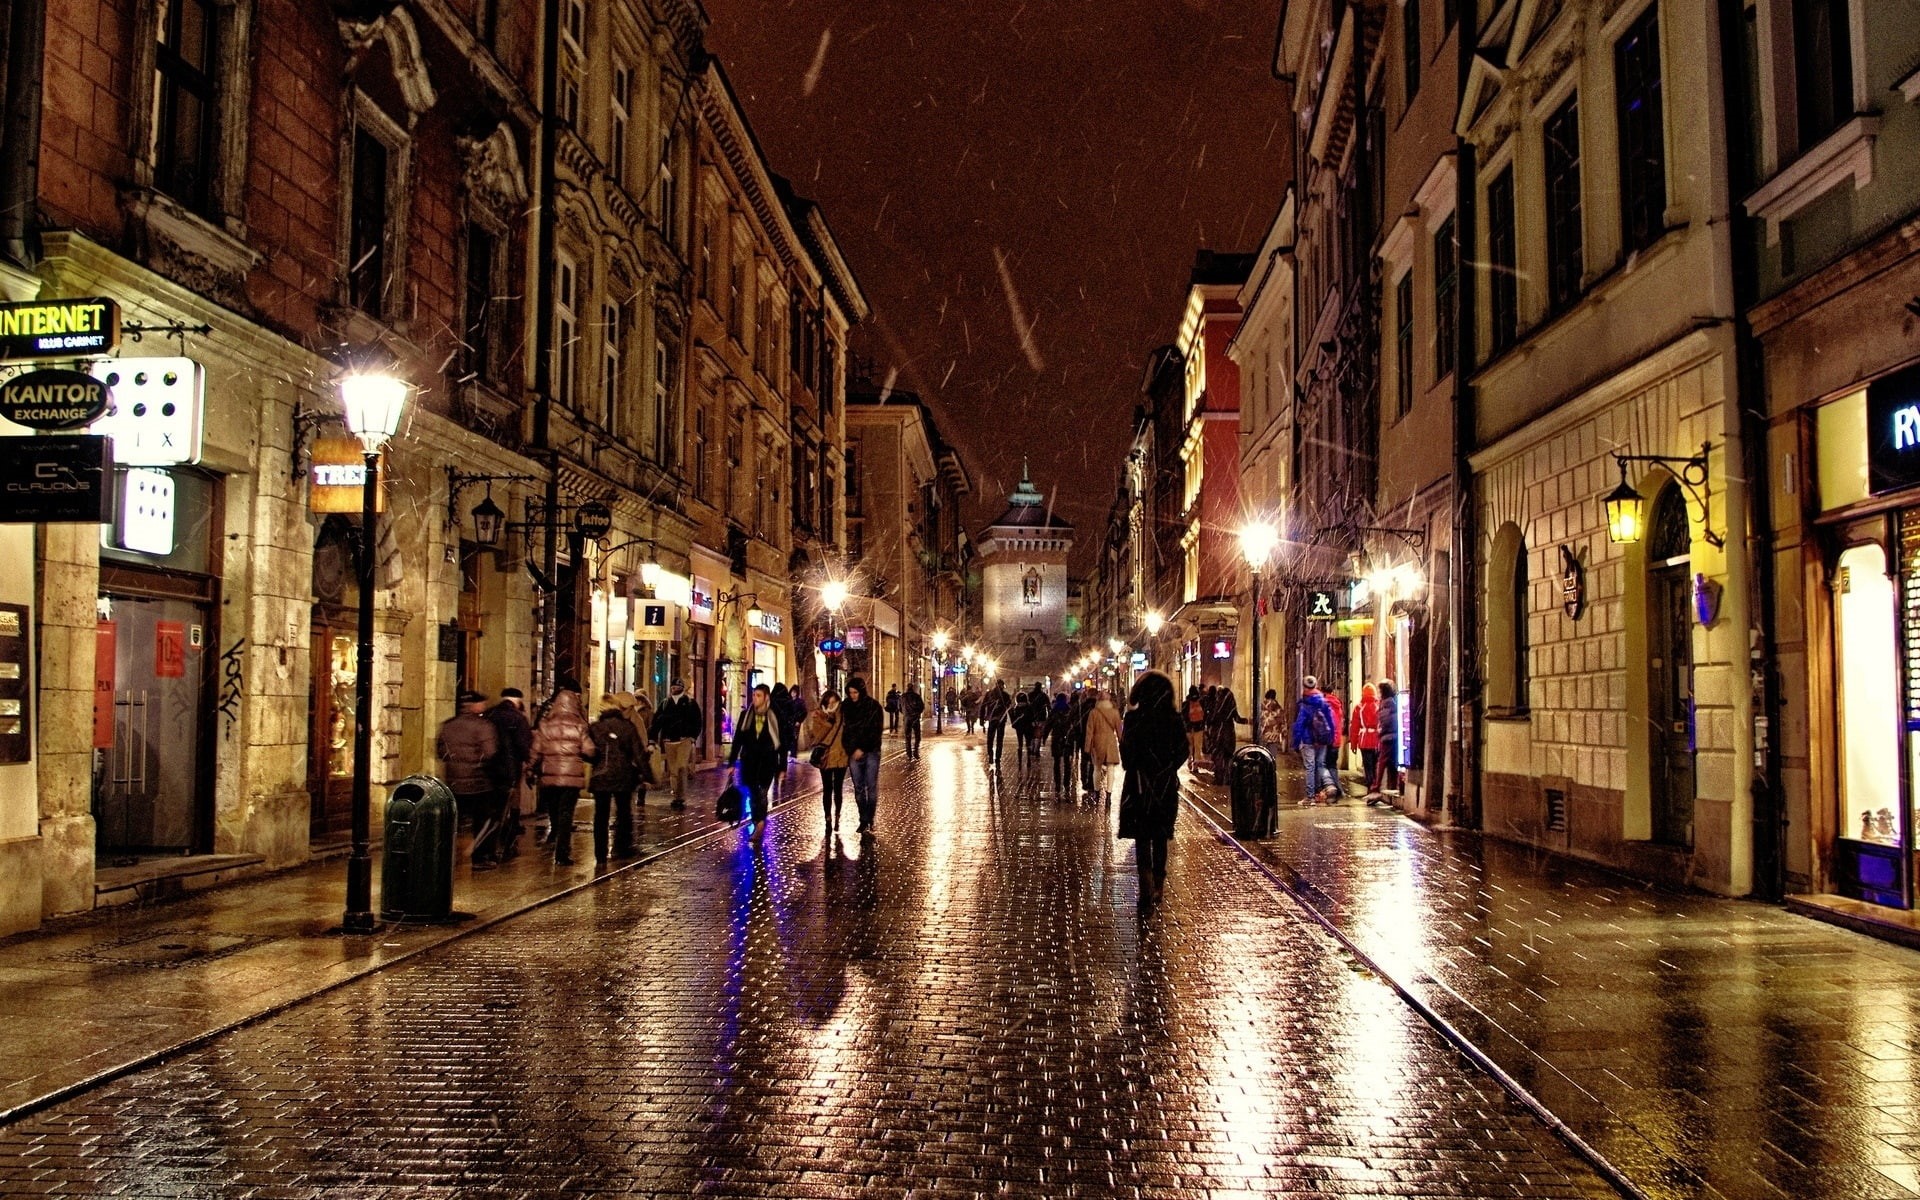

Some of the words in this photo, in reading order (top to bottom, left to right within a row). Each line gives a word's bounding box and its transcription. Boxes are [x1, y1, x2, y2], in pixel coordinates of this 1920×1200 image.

[0, 304, 105, 336] INTERNET
[38, 338, 63, 350] KLUB
[4, 384, 100, 404] KANTOR
[14, 408, 88, 420] EXCHANGE
[579, 511, 610, 526] Tattoo
